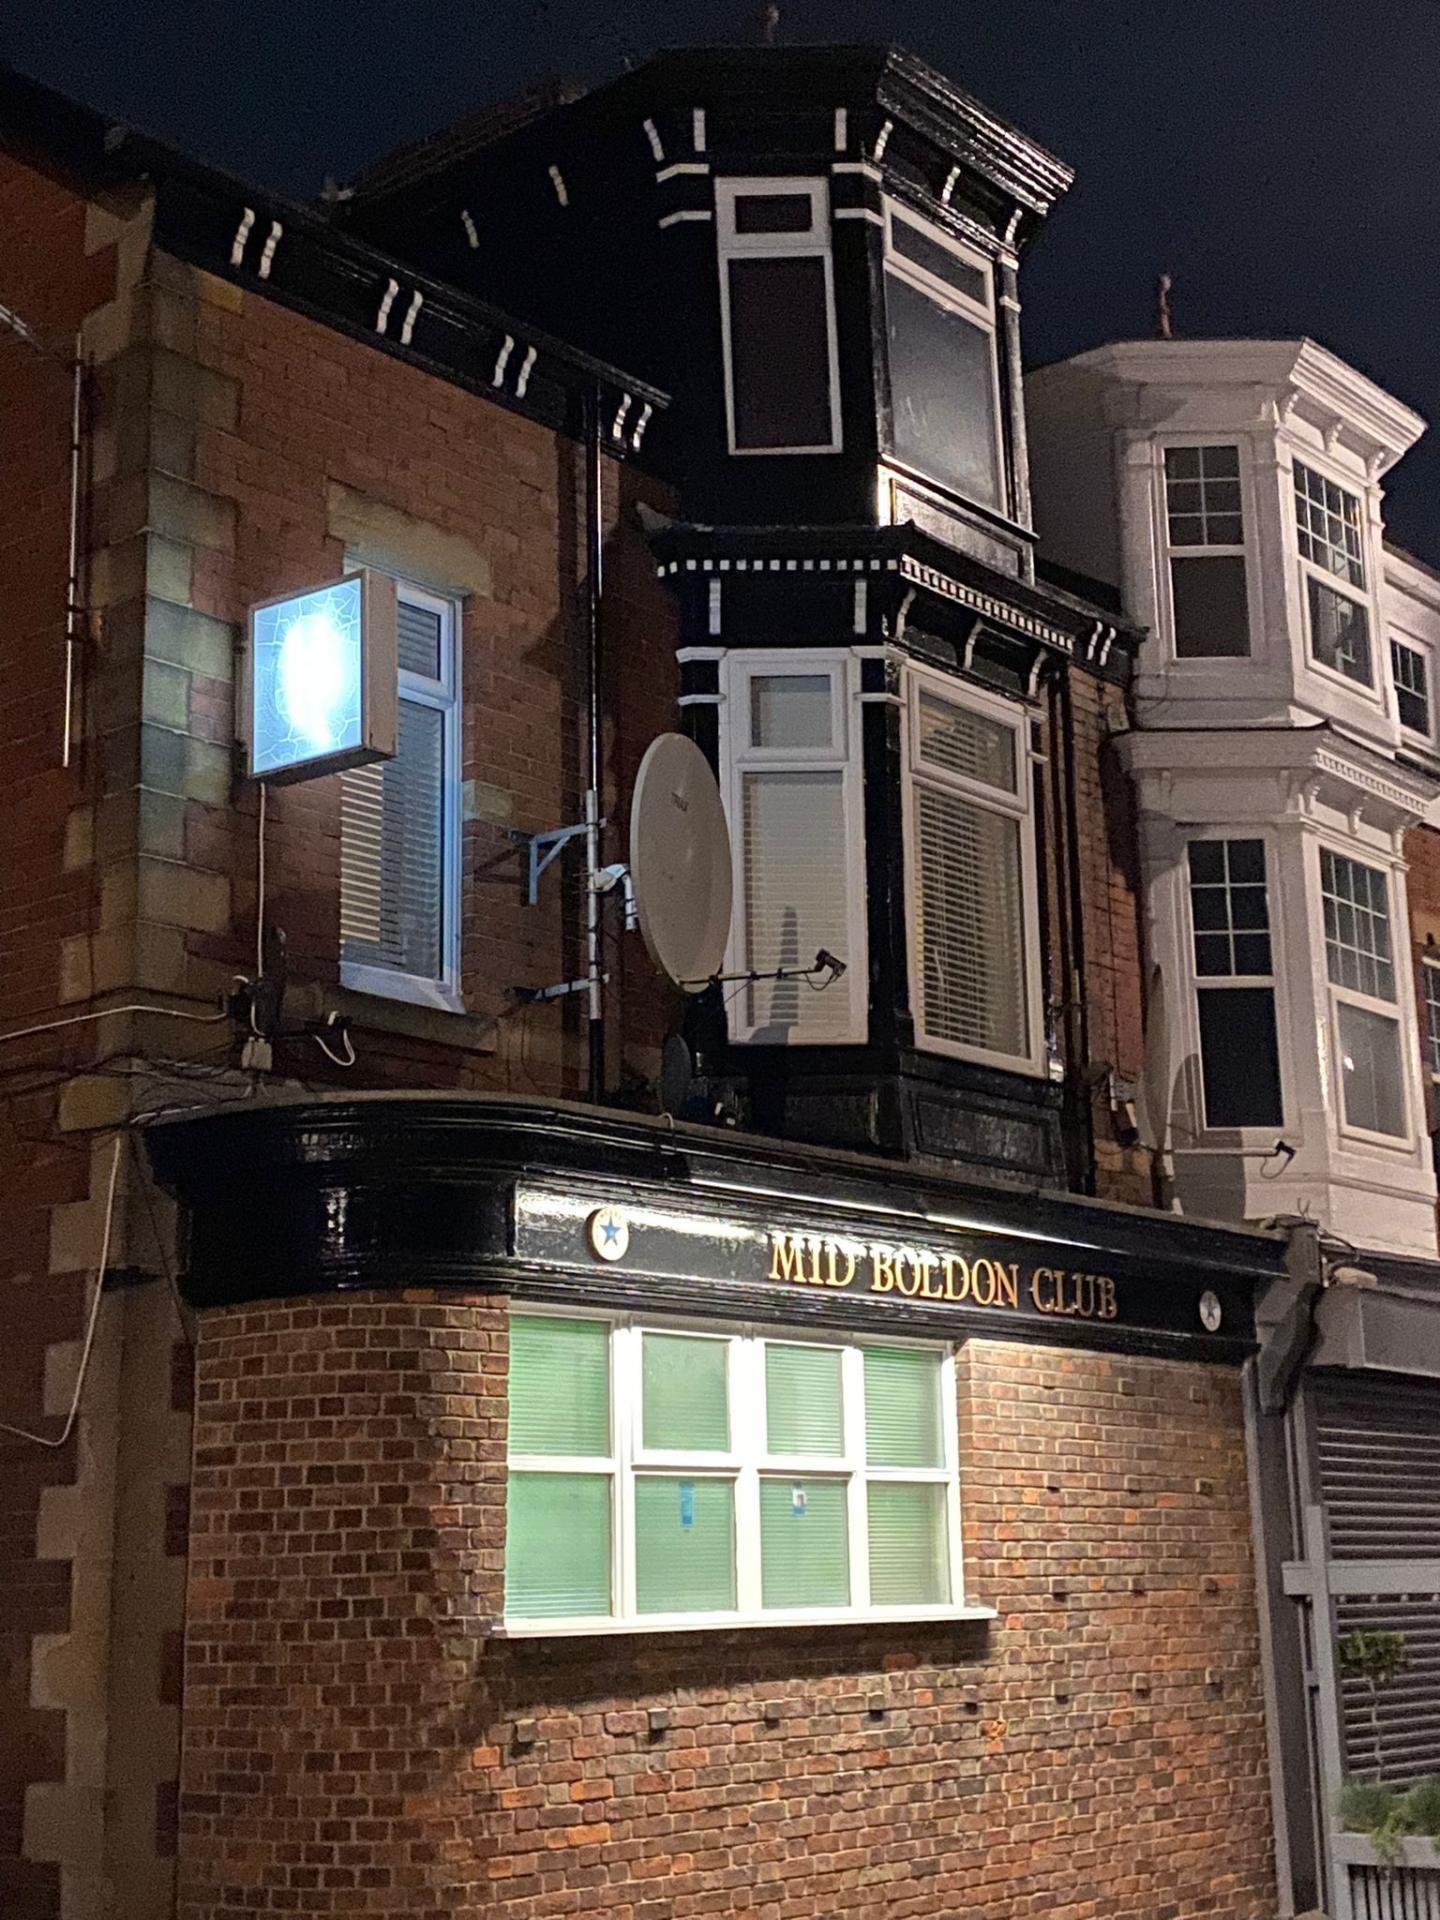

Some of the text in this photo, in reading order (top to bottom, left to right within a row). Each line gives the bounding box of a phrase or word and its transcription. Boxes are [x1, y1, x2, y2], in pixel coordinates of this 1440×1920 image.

[769, 1229, 1117, 1319] MID BOLDON CLUB
